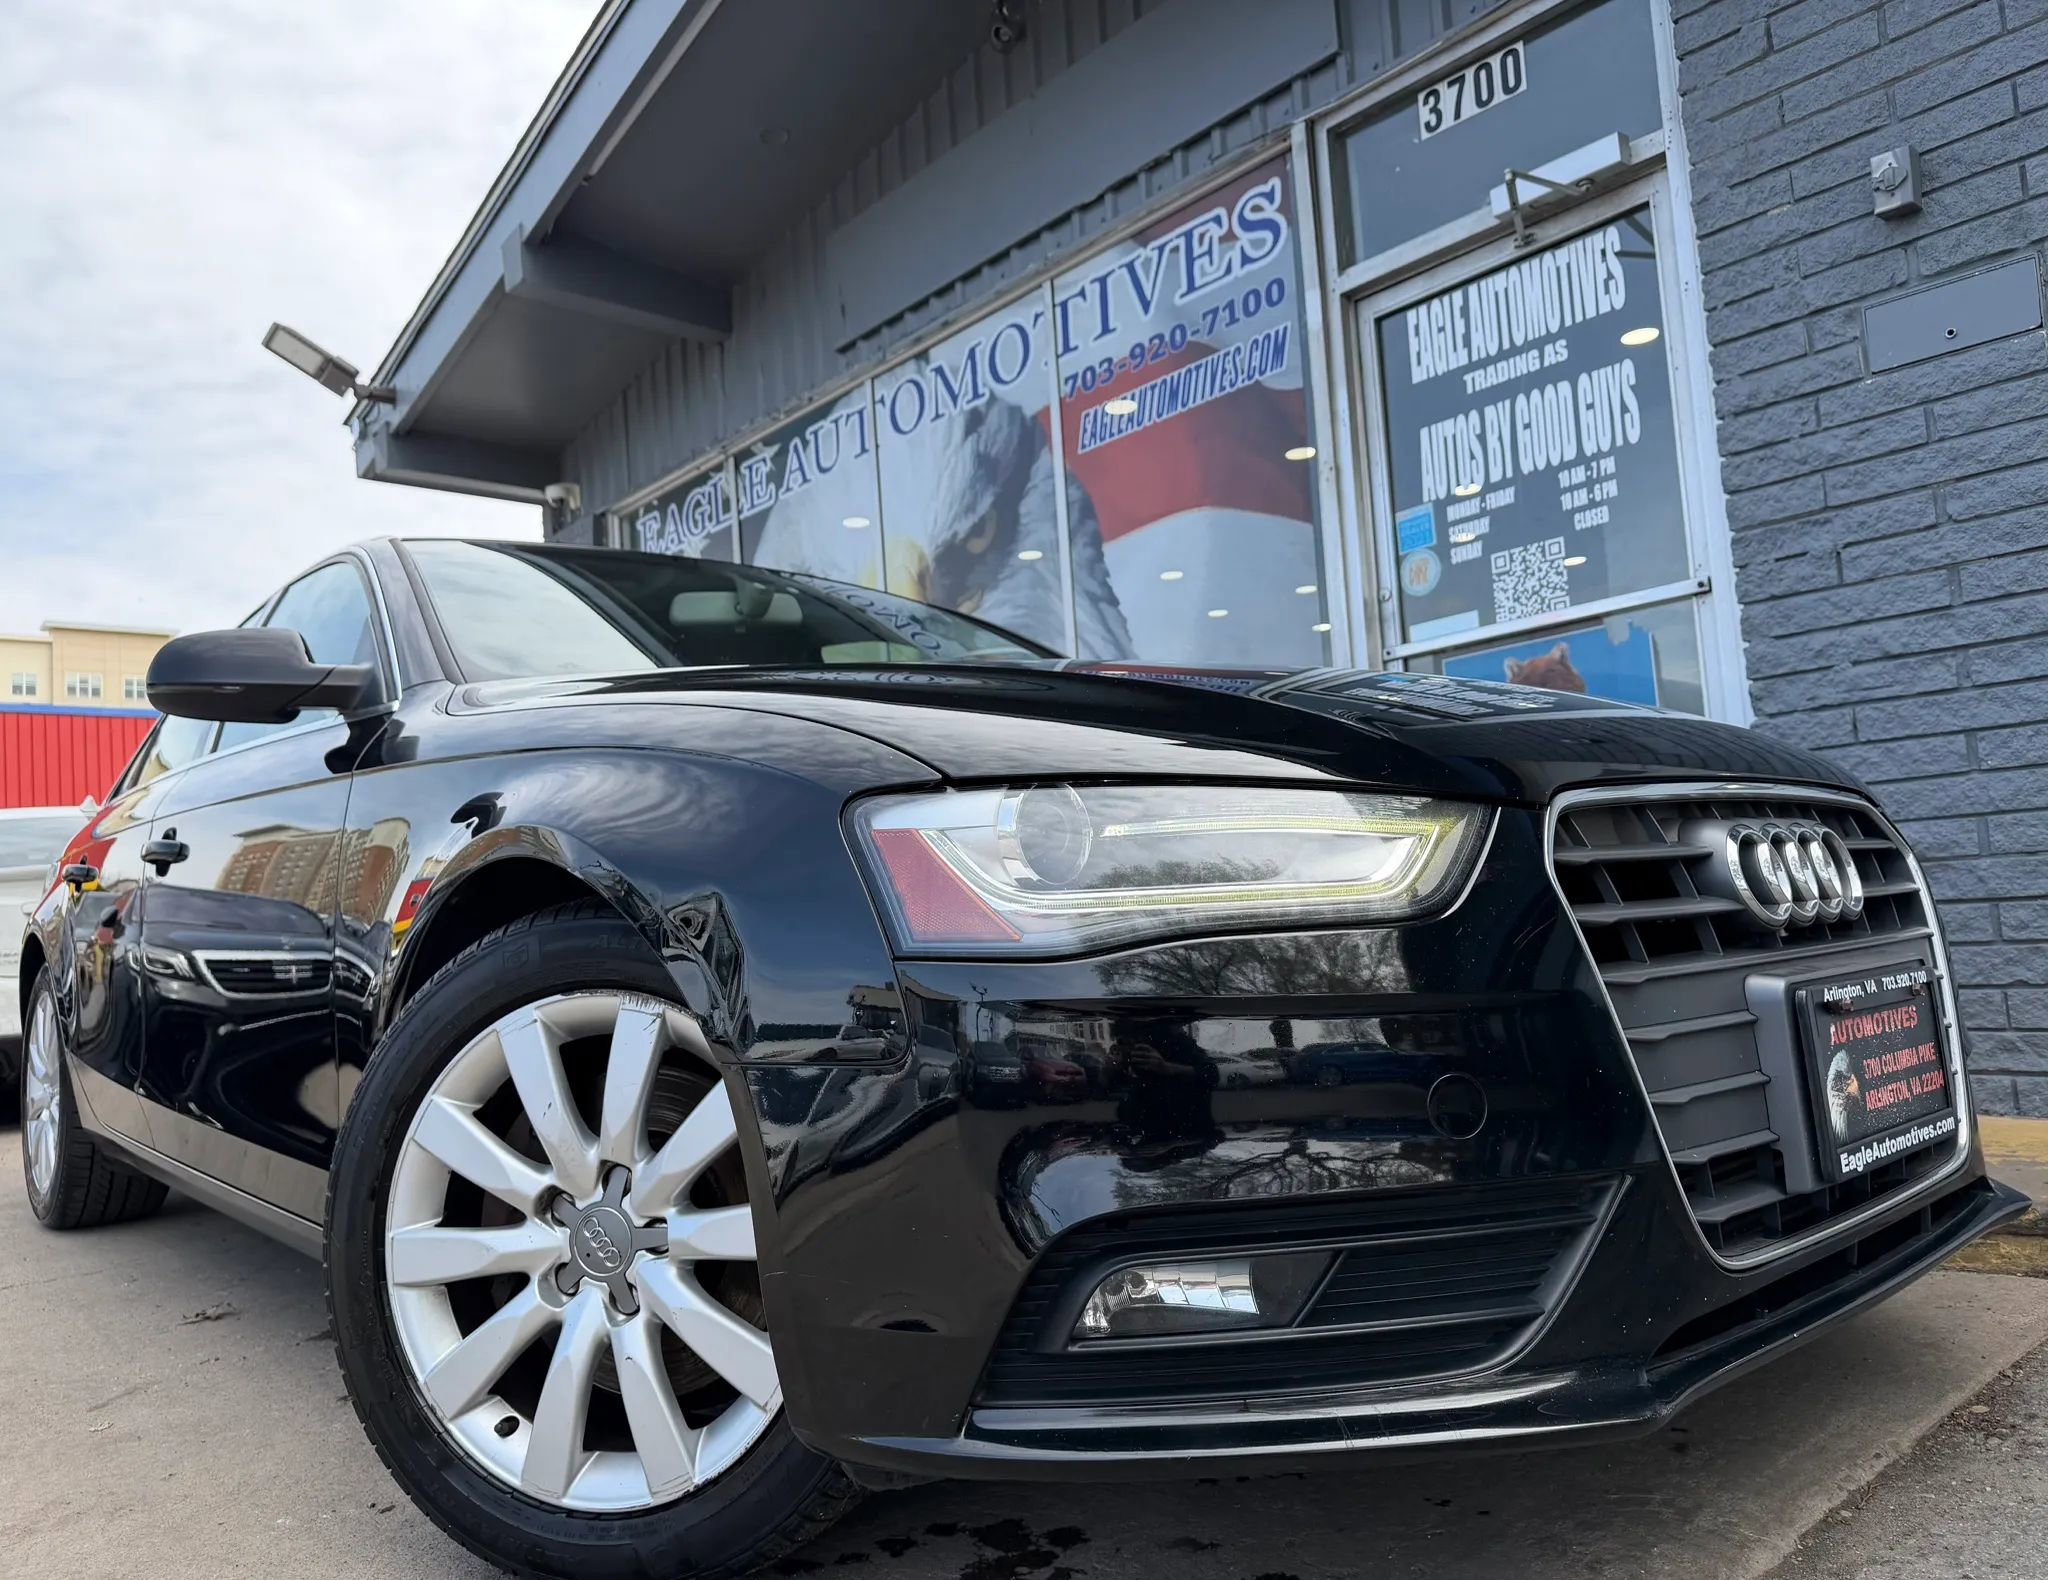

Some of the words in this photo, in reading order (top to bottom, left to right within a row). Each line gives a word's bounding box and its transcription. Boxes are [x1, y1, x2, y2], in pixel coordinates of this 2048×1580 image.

[1421, 47, 1523, 134] 3700
[1406, 291, 1468, 384] EAGLE
[1468, 226, 1626, 362] AUTOMOTIVES
[638, 453, 777, 553] EAGLE
[779, 178, 1288, 500] AUTOMOTIVES
[1064, 276, 1286, 399] 703-920-7100
[1462, 349, 1541, 395] TRADING
[1543, 338, 1569, 368] AS
[1080, 324, 1290, 452] EAGLEAUTOMOTIVES.COM
[1420, 409, 1486, 503] AUTOS
[1484, 399, 1514, 483] BY
[1515, 380, 1577, 476] GOOD
[1577, 358, 1641, 457] GUYS
[1558, 469, 1570, 489] 10
[1570, 464, 1586, 486] AM
[1590, 460, 1598, 479] 7
[1600, 455, 1616, 477] PM
[1448, 515, 1490, 545] SATURDAY
[1560, 492, 1573, 512] 10
[1573, 487, 1589, 508] AM
[1602, 478, 1618, 500] PM
[1450, 539, 1482, 565] SUNDAY
[1573, 505, 1610, 531] CLOSED
[1823, 984, 1865, 1003] Arlington,
[1864, 979, 1878, 995] VA
[1881, 970, 1927, 991] 703.920.7100
[1829, 1004, 1919, 1046] AUTOMOTIVES
[1863, 1057, 1882, 1080] 3700
[1881, 1046, 1919, 1074] COLUMBIA
[1918, 1041, 1937, 1063] PIKE
[1865, 1079, 1912, 1112] ARLINGTON,
[1909, 1075, 1922, 1096] VA
[1921, 1068, 1945, 1093] 22204
[1840, 1115, 1956, 1174] EagleAutomotives.com
